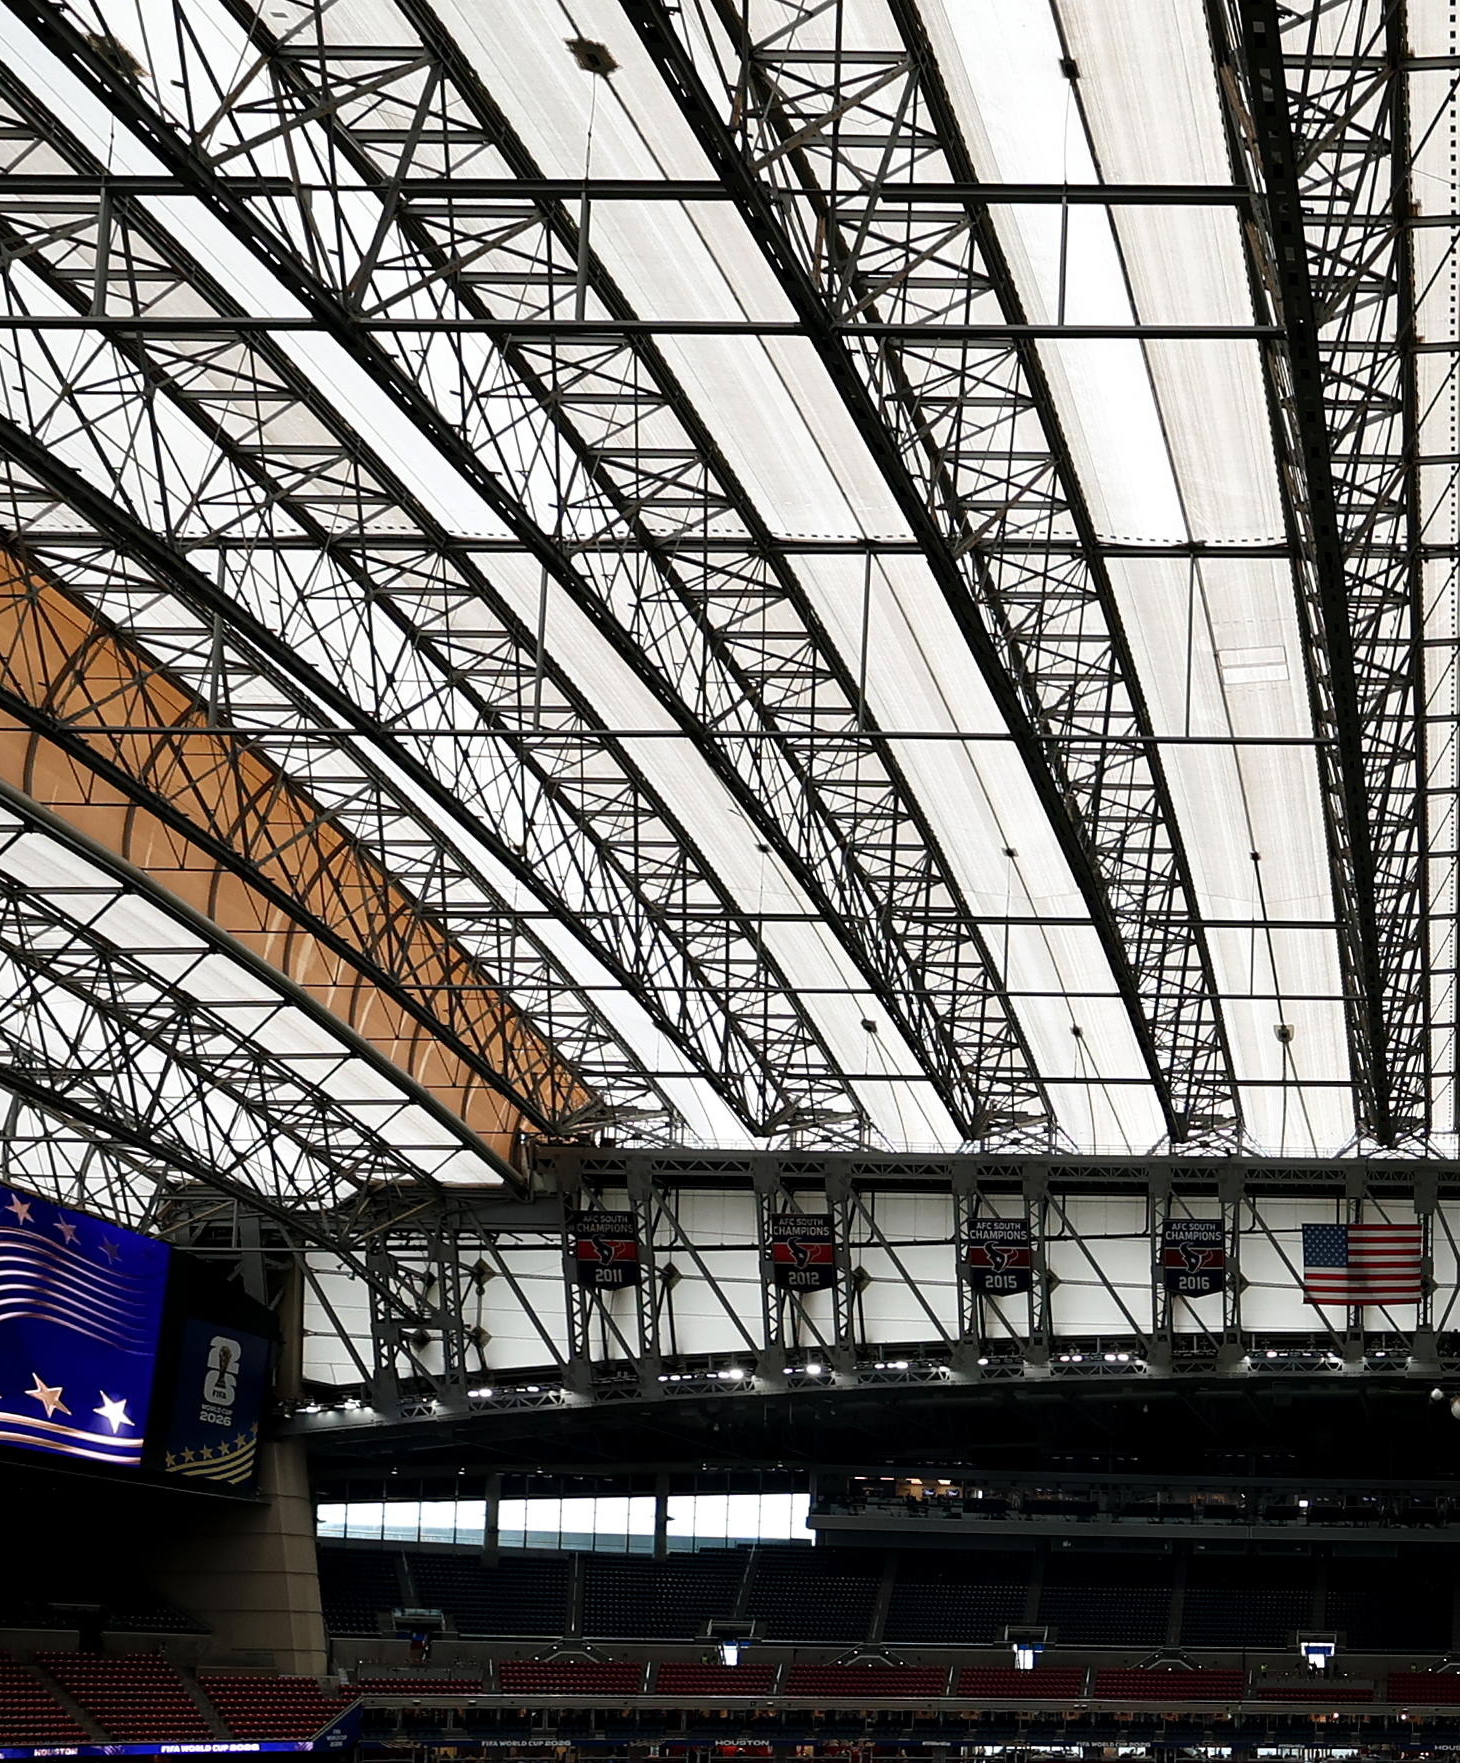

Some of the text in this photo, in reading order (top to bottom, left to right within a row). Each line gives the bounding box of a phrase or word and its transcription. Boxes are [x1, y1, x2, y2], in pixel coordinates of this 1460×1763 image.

[577, 1224, 633, 1233] CHAMPIONS
[774, 1226, 829, 1236] CHAMPIONS
[970, 1231, 1027, 1240] CHAMPIONS
[1165, 1231, 1222, 1240] CHAMPIONS
[595, 1269, 622, 1282] 2011
[788, 1272, 820, 1285] 2012
[985, 1275, 1017, 1289] 2015
[1179, 1277, 1210, 1289] 2016
[199, 1411, 232, 1427] 2026
[34, 1748, 78, 1757] HOUSTON
